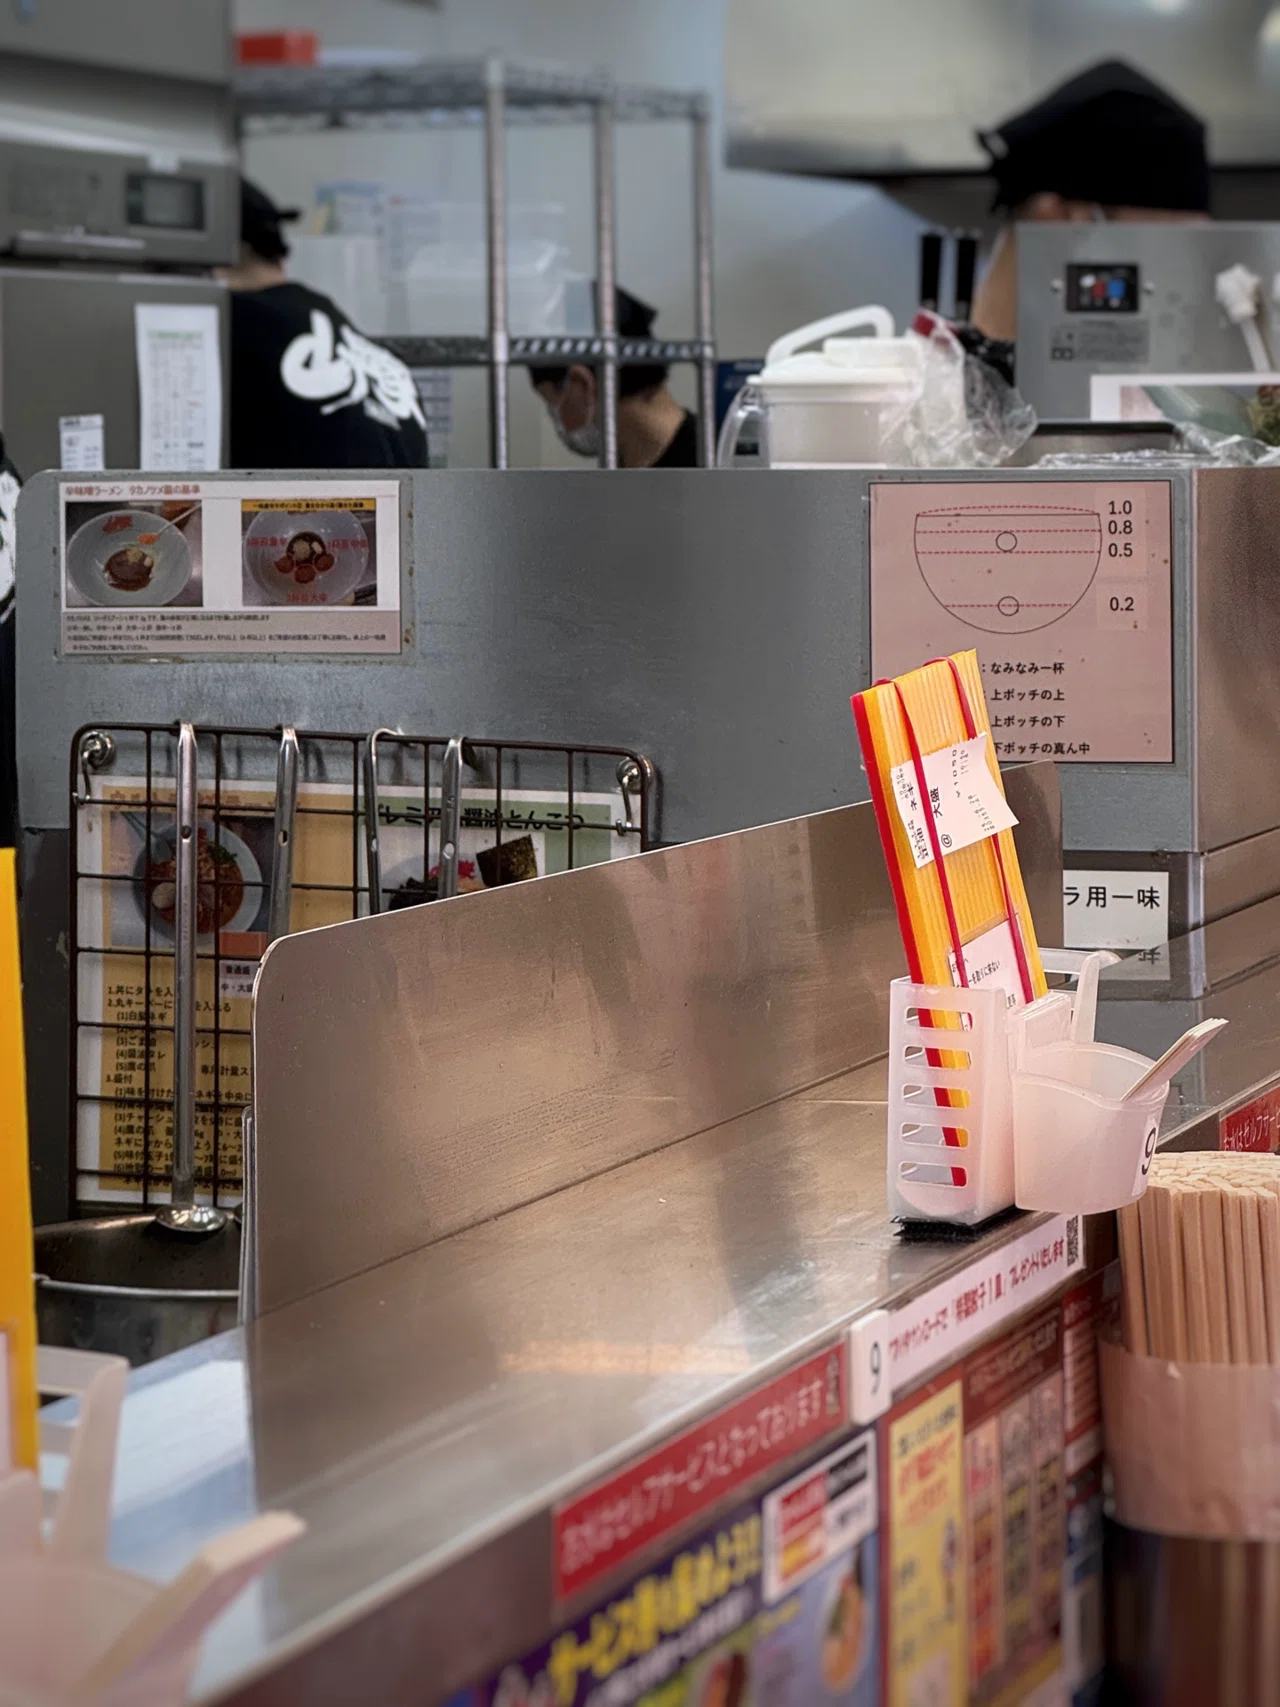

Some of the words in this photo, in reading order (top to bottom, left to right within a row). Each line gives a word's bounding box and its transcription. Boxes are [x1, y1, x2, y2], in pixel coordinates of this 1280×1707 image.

[1108, 500, 1132, 515] 1.0
[1108, 520, 1133, 535] 0.8
[1108, 543, 1133, 557] 0.5
[1110, 597, 1134, 612] 0.2
[991, 715, 1065, 728] 上ボッチの下
[1063, 886, 1160, 909] ラ用一味
[1141, 1127, 1157, 1175] 9
[868, 1339, 882, 1396] 9
